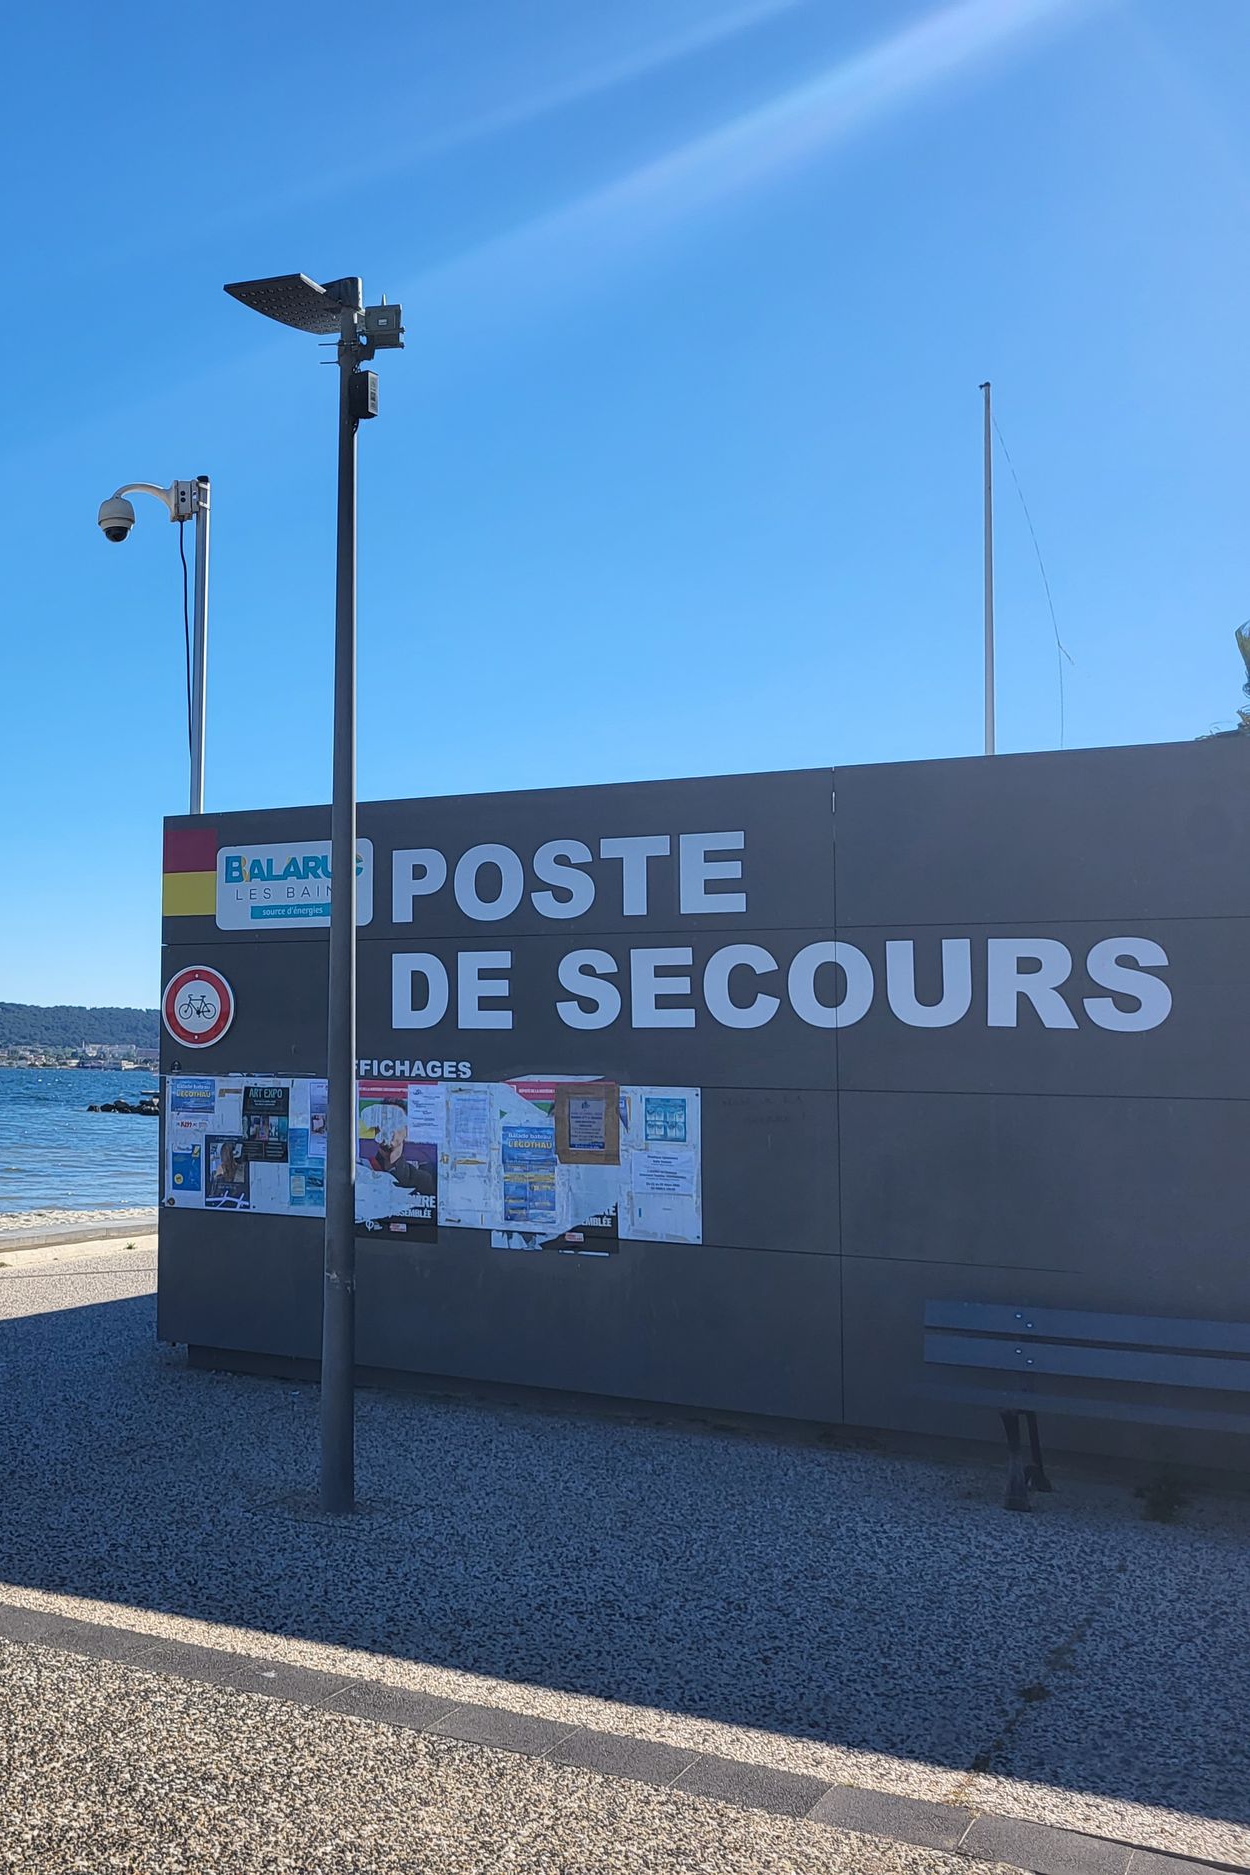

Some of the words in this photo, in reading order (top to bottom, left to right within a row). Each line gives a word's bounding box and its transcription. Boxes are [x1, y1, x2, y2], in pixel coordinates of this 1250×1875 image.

[391, 830, 746, 924] POSTE
[235, 887, 271, 901] LES
[262, 908, 286, 916] source
[287, 905, 323, 917] d'énergies
[391, 950, 513, 1030] DE
[556, 936, 1173, 1033] SECOURS
[355, 1059, 472, 1079] FICHAGES
[249, 1088, 263, 1098] ART
[264, 1088, 283, 1099] EXPO
